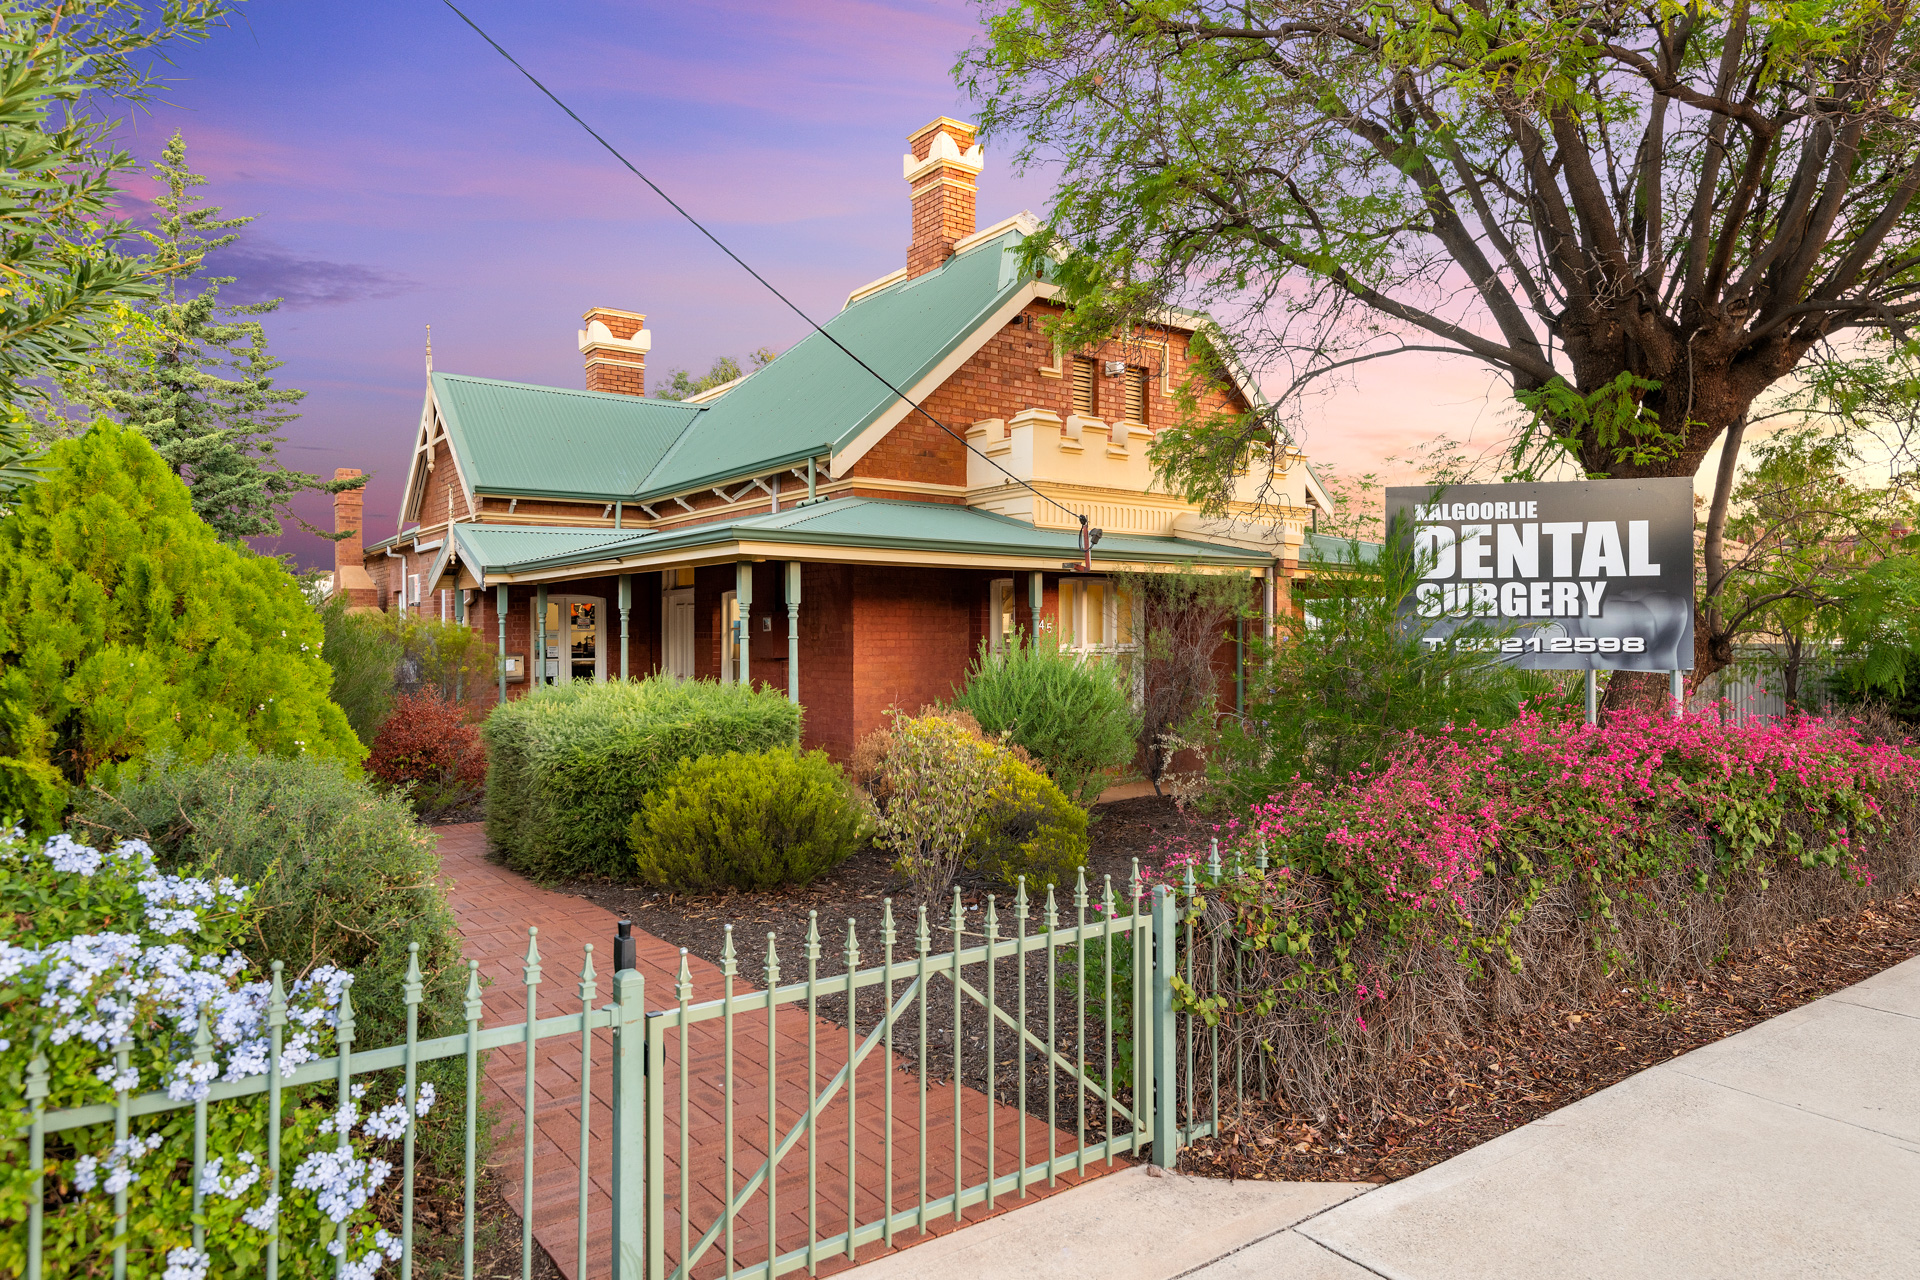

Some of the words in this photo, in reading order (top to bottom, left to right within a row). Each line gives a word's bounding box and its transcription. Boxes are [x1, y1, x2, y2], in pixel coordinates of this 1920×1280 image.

[1414, 501, 1537, 521] KALGOORLIE
[1413, 520, 1661, 579] DENTAL
[1415, 581, 1607, 617] SURGERY
[1550, 637, 1645, 653] 2598
